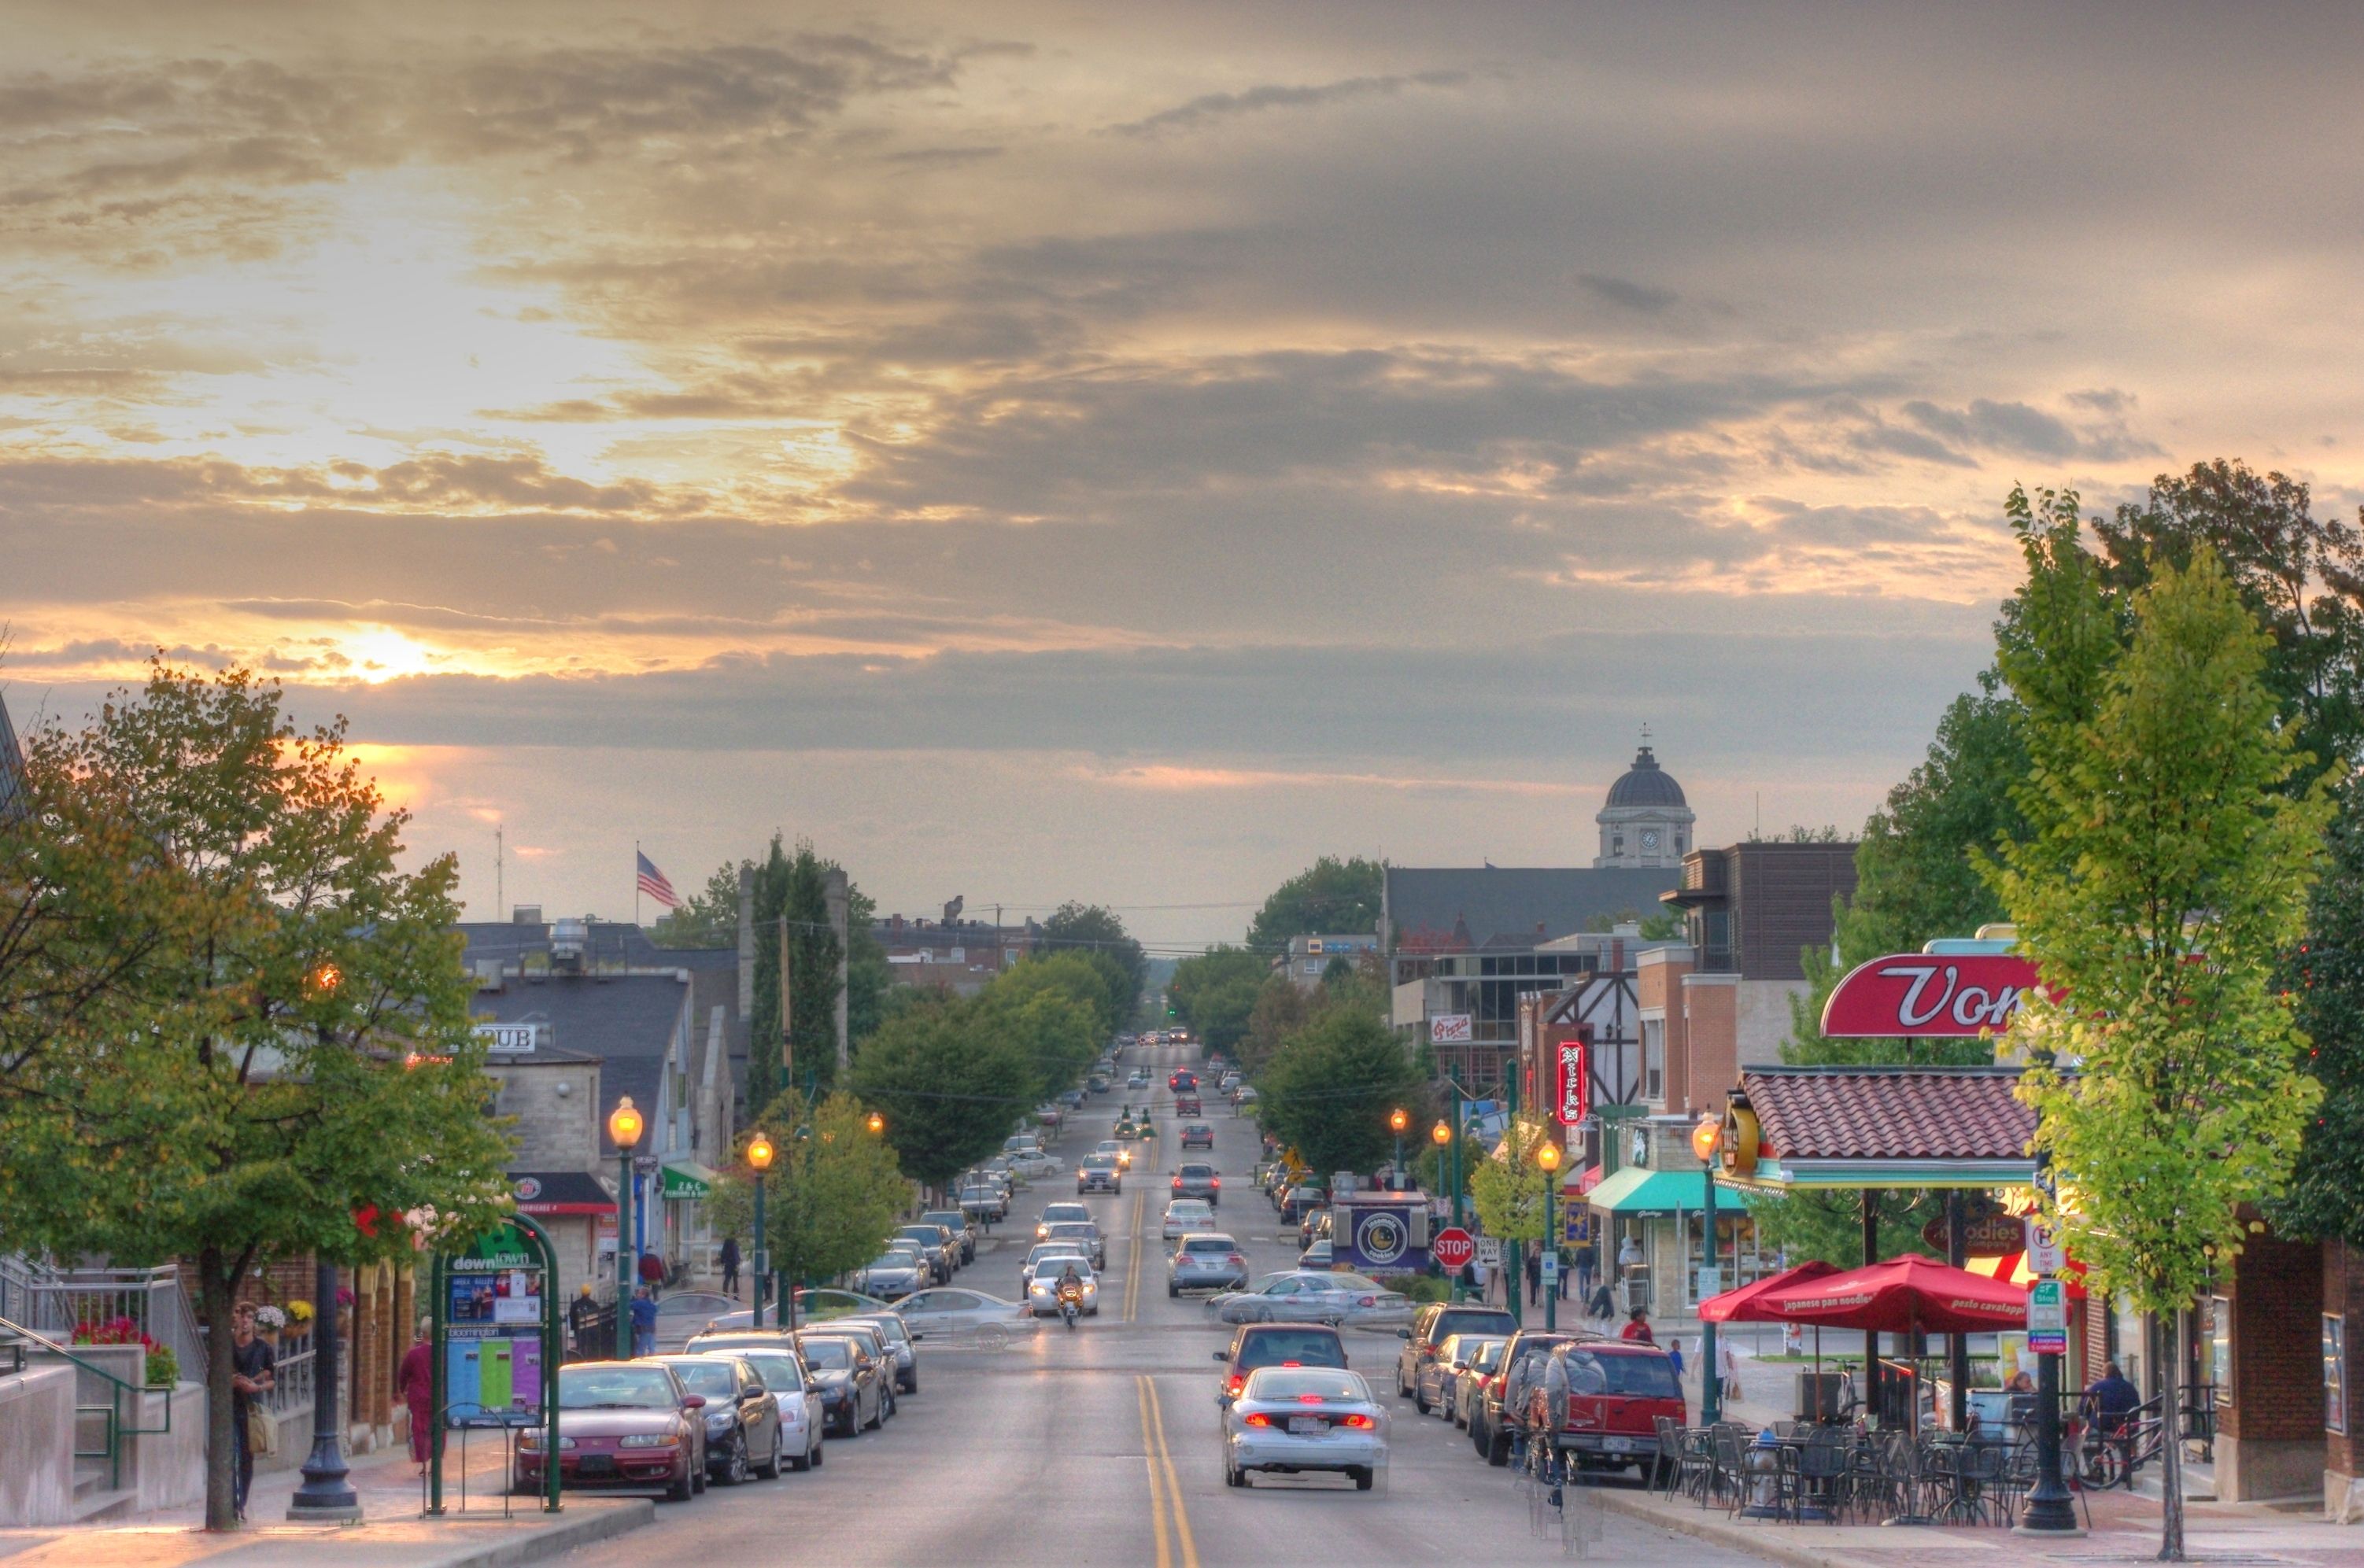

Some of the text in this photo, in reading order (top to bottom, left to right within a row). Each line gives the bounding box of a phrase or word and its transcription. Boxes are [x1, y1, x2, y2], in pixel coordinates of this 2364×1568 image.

[1434, 1017, 1468, 1040] Pizza
[1561, 1046, 1580, 1120] Nick's
[1368, 1218, 1398, 1229] insomnia
[1437, 1240, 1471, 1255] STOP
[1967, 1240, 2011, 1249] company
[1369, 1250, 1394, 1259] cookies
[2037, 1294, 2056, 1303] Stop
[1783, 1300, 1820, 1312] japanese
[1822, 1298, 1838, 1309] pan
[1952, 1298, 2026, 1315] pesto cavatappi
[449, 1327, 499, 1337] bloomington
